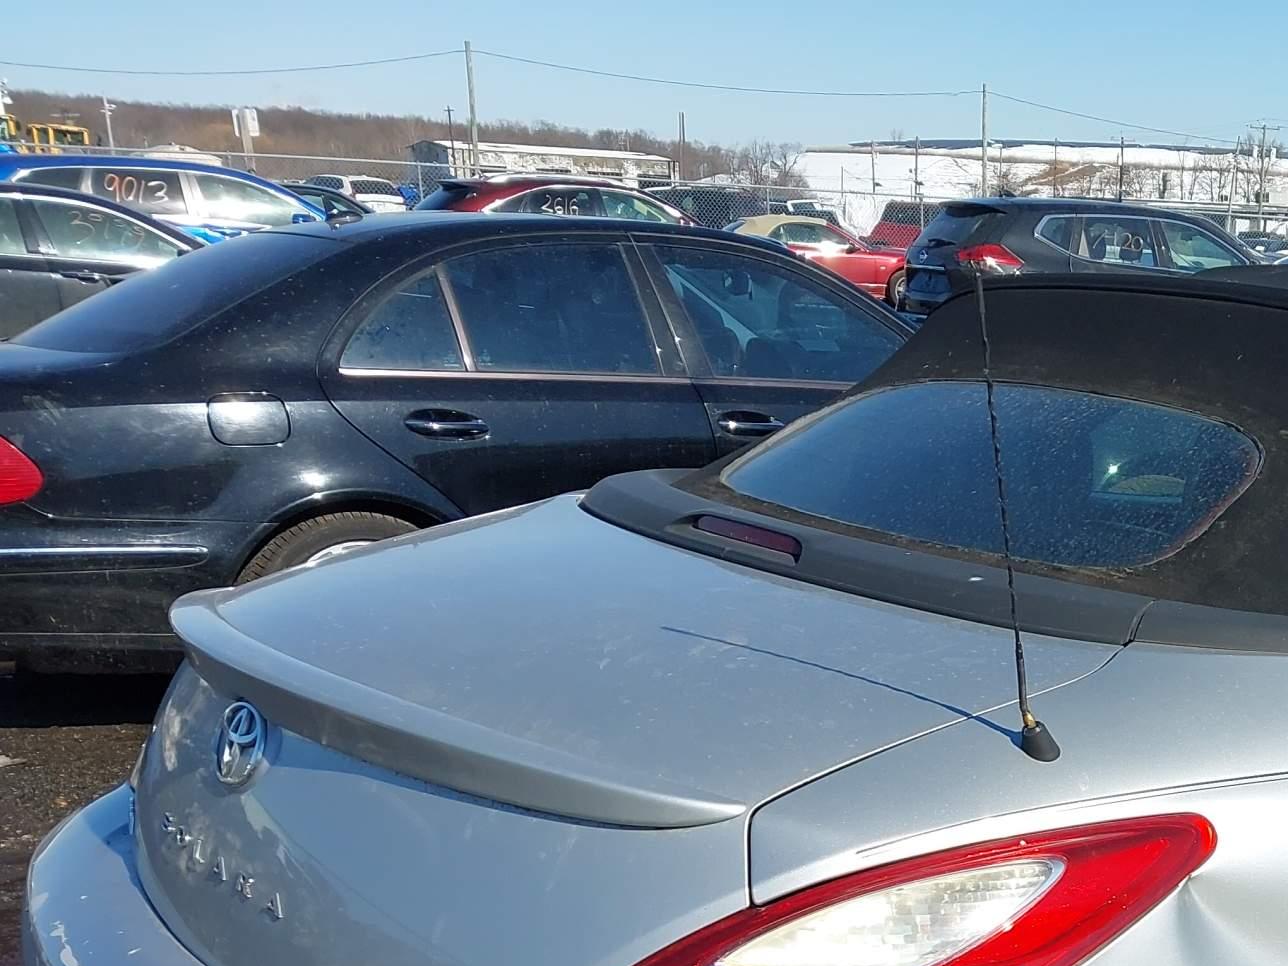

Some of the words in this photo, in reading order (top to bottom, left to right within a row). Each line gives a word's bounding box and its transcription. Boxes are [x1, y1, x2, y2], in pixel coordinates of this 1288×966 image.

[103, 173, 169, 204] 9013
[541, 194, 579, 216] 2616
[161, 811, 284, 919] SOLARA
